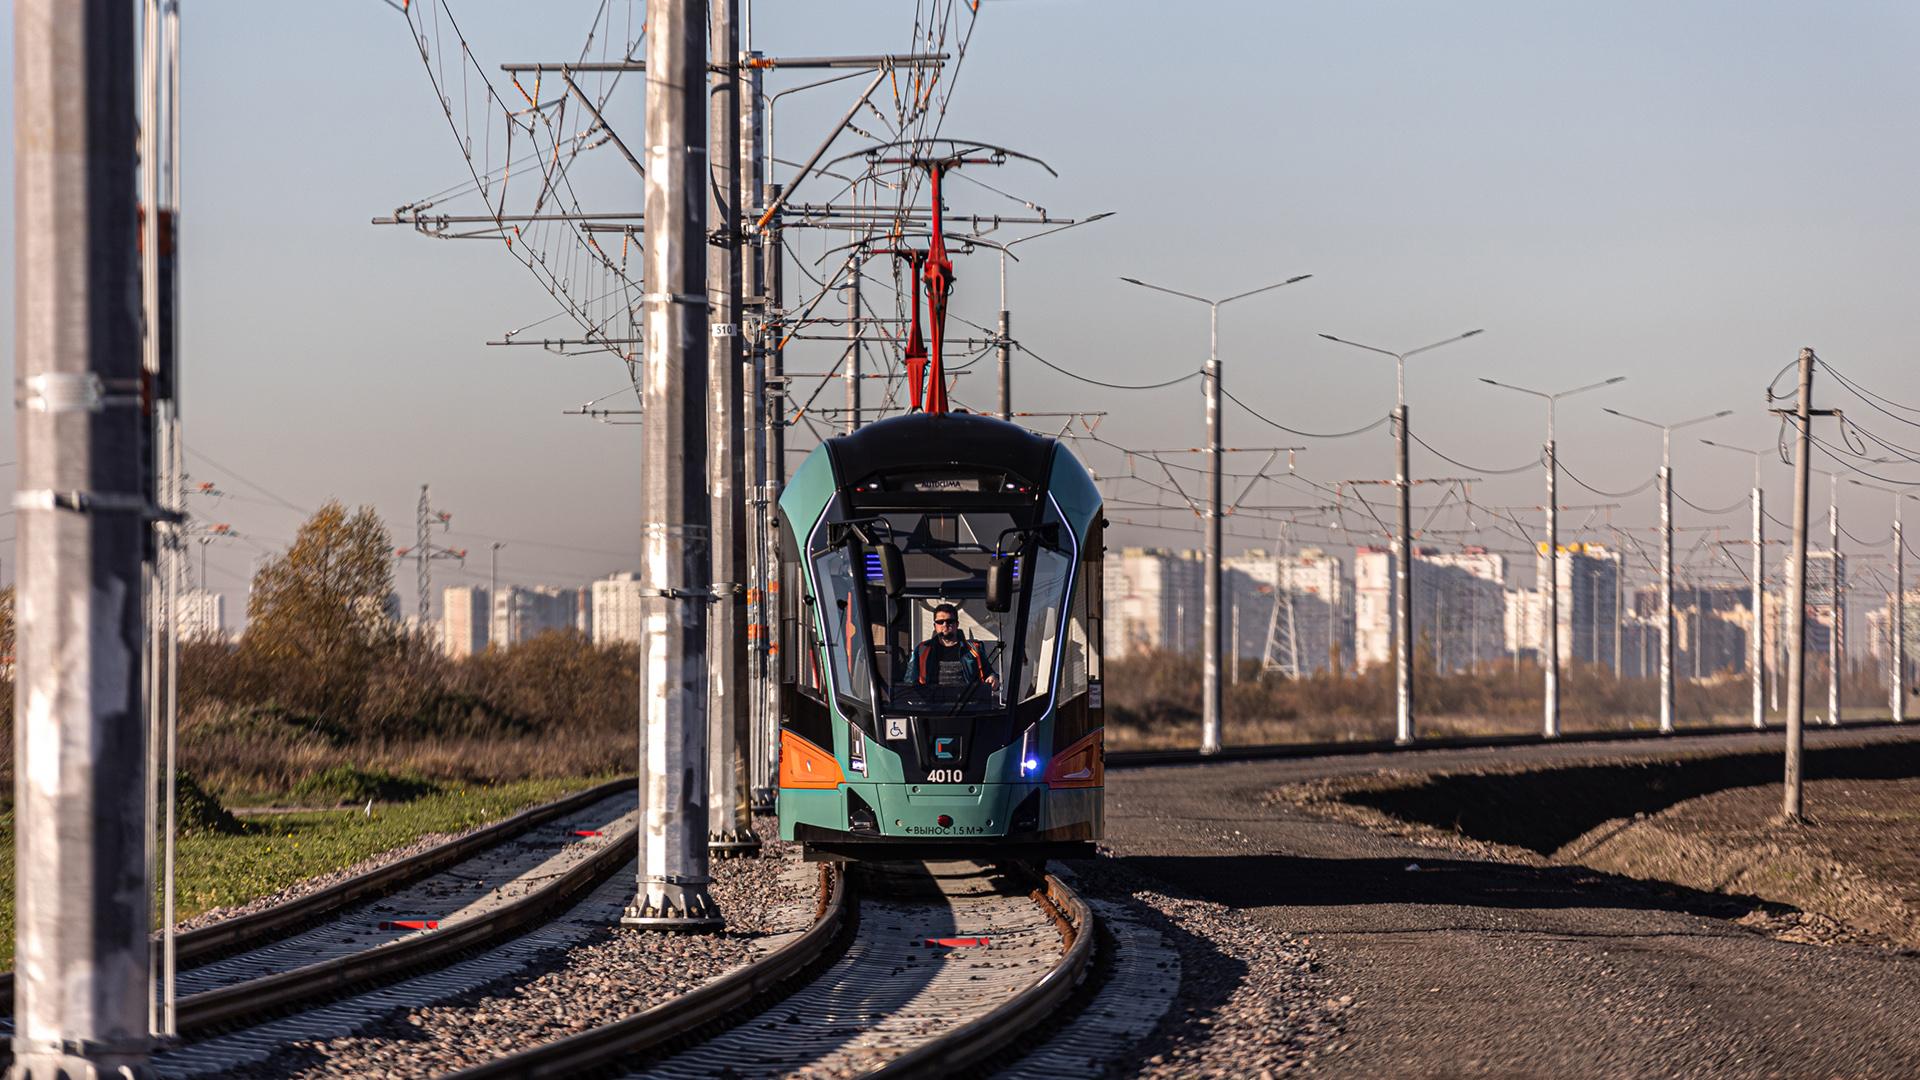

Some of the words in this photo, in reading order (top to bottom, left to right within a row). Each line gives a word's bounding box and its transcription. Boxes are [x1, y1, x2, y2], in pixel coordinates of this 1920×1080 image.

[716, 325, 733, 335] 510
[927, 769, 963, 783] 4010
[913, 826, 951, 835] ВЫНОС
